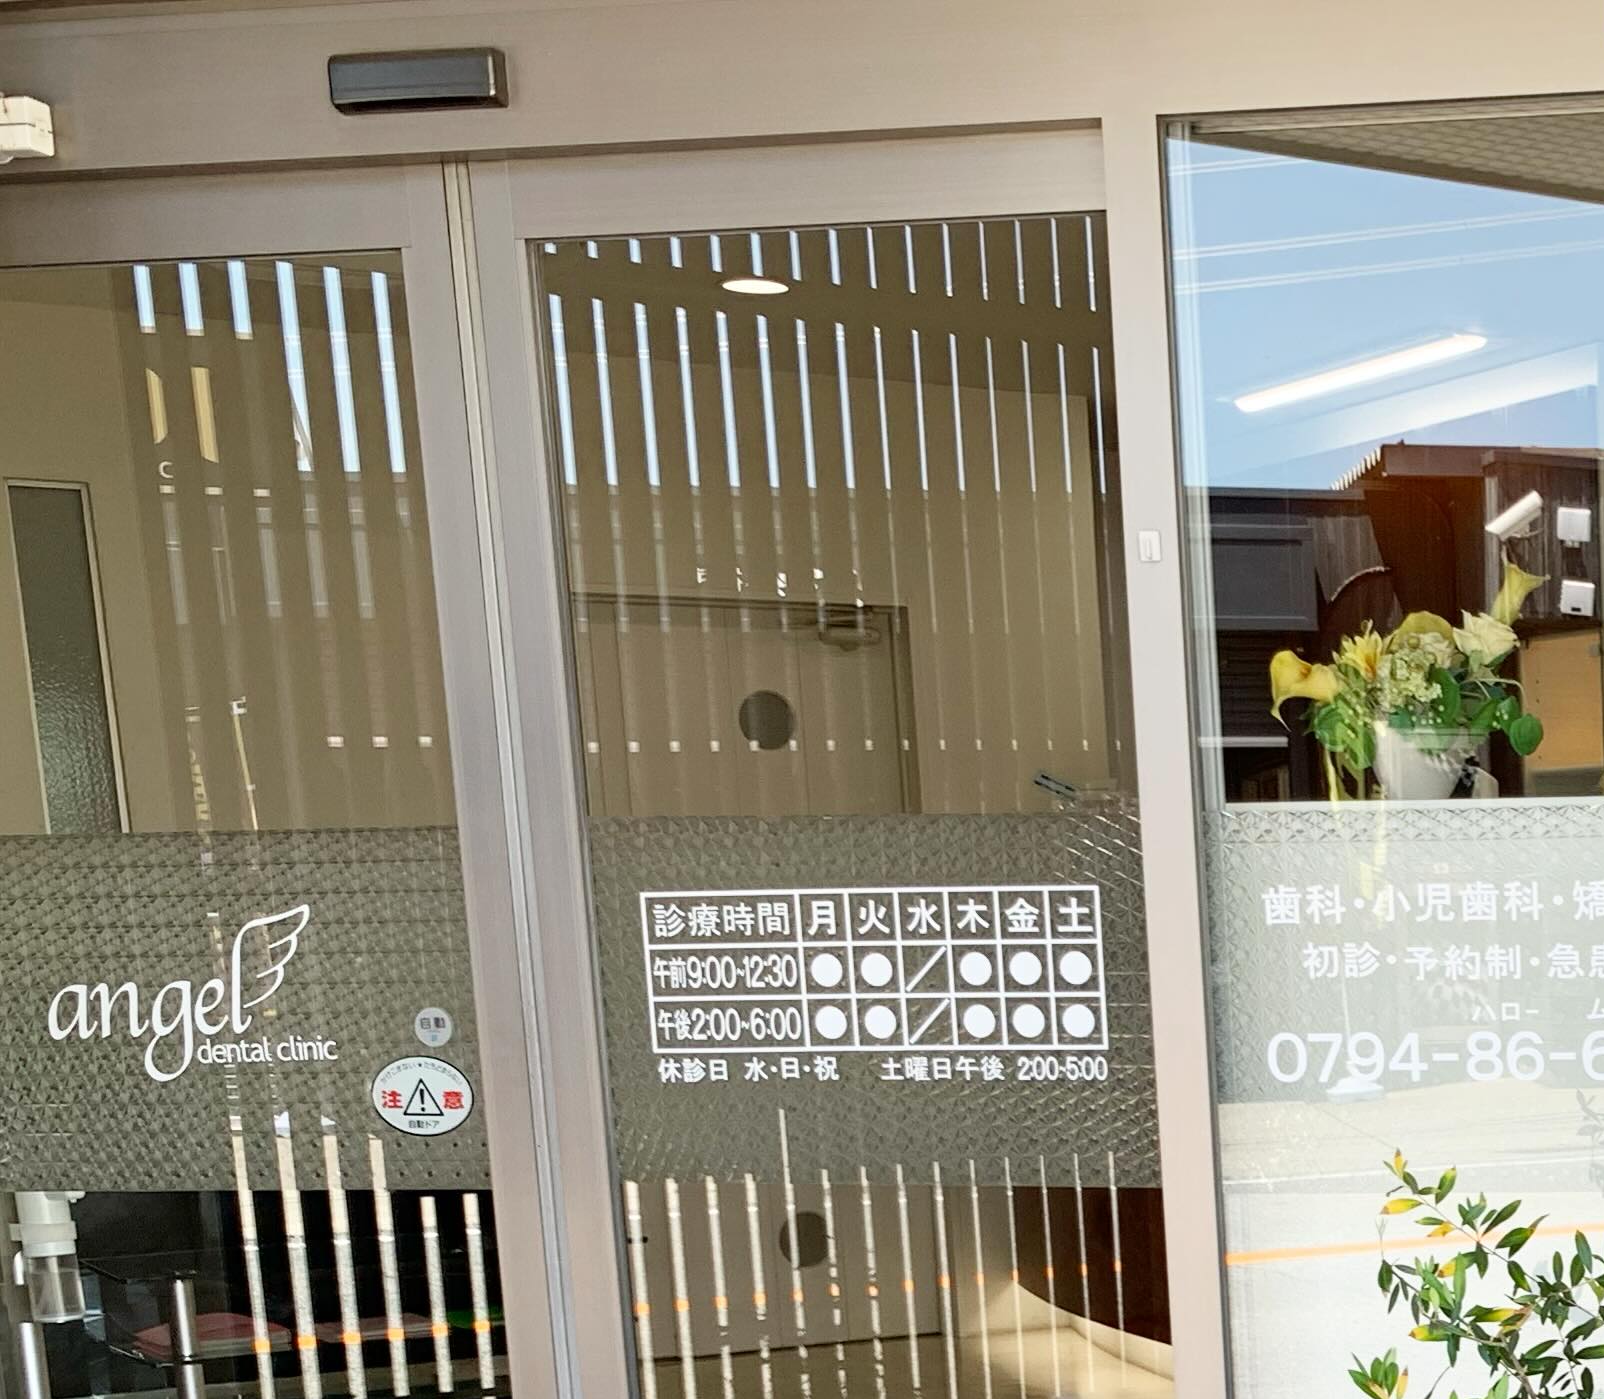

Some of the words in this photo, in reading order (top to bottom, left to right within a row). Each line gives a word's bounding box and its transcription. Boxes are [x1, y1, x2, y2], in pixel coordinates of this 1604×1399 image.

[652, 902, 791, 938] 診療時間
[808, 901, 837, 936] 月
[858, 899, 890, 935] 火
[907, 898, 941, 935] 水
[956, 898, 990, 934] 木
[1005, 897, 1040, 933] 金
[1057, 897, 1094, 932] 土
[48, 904, 310, 1082] angel
[420, 1017, 446, 1030] 自動
[197, 1035, 272, 1064] dental
[276, 1034, 338, 1061] clinic
[658, 1056, 729, 1083] 休診日
[880, 1055, 1005, 1082] 土曜日午後
[382, 1090, 403, 1109] 注
